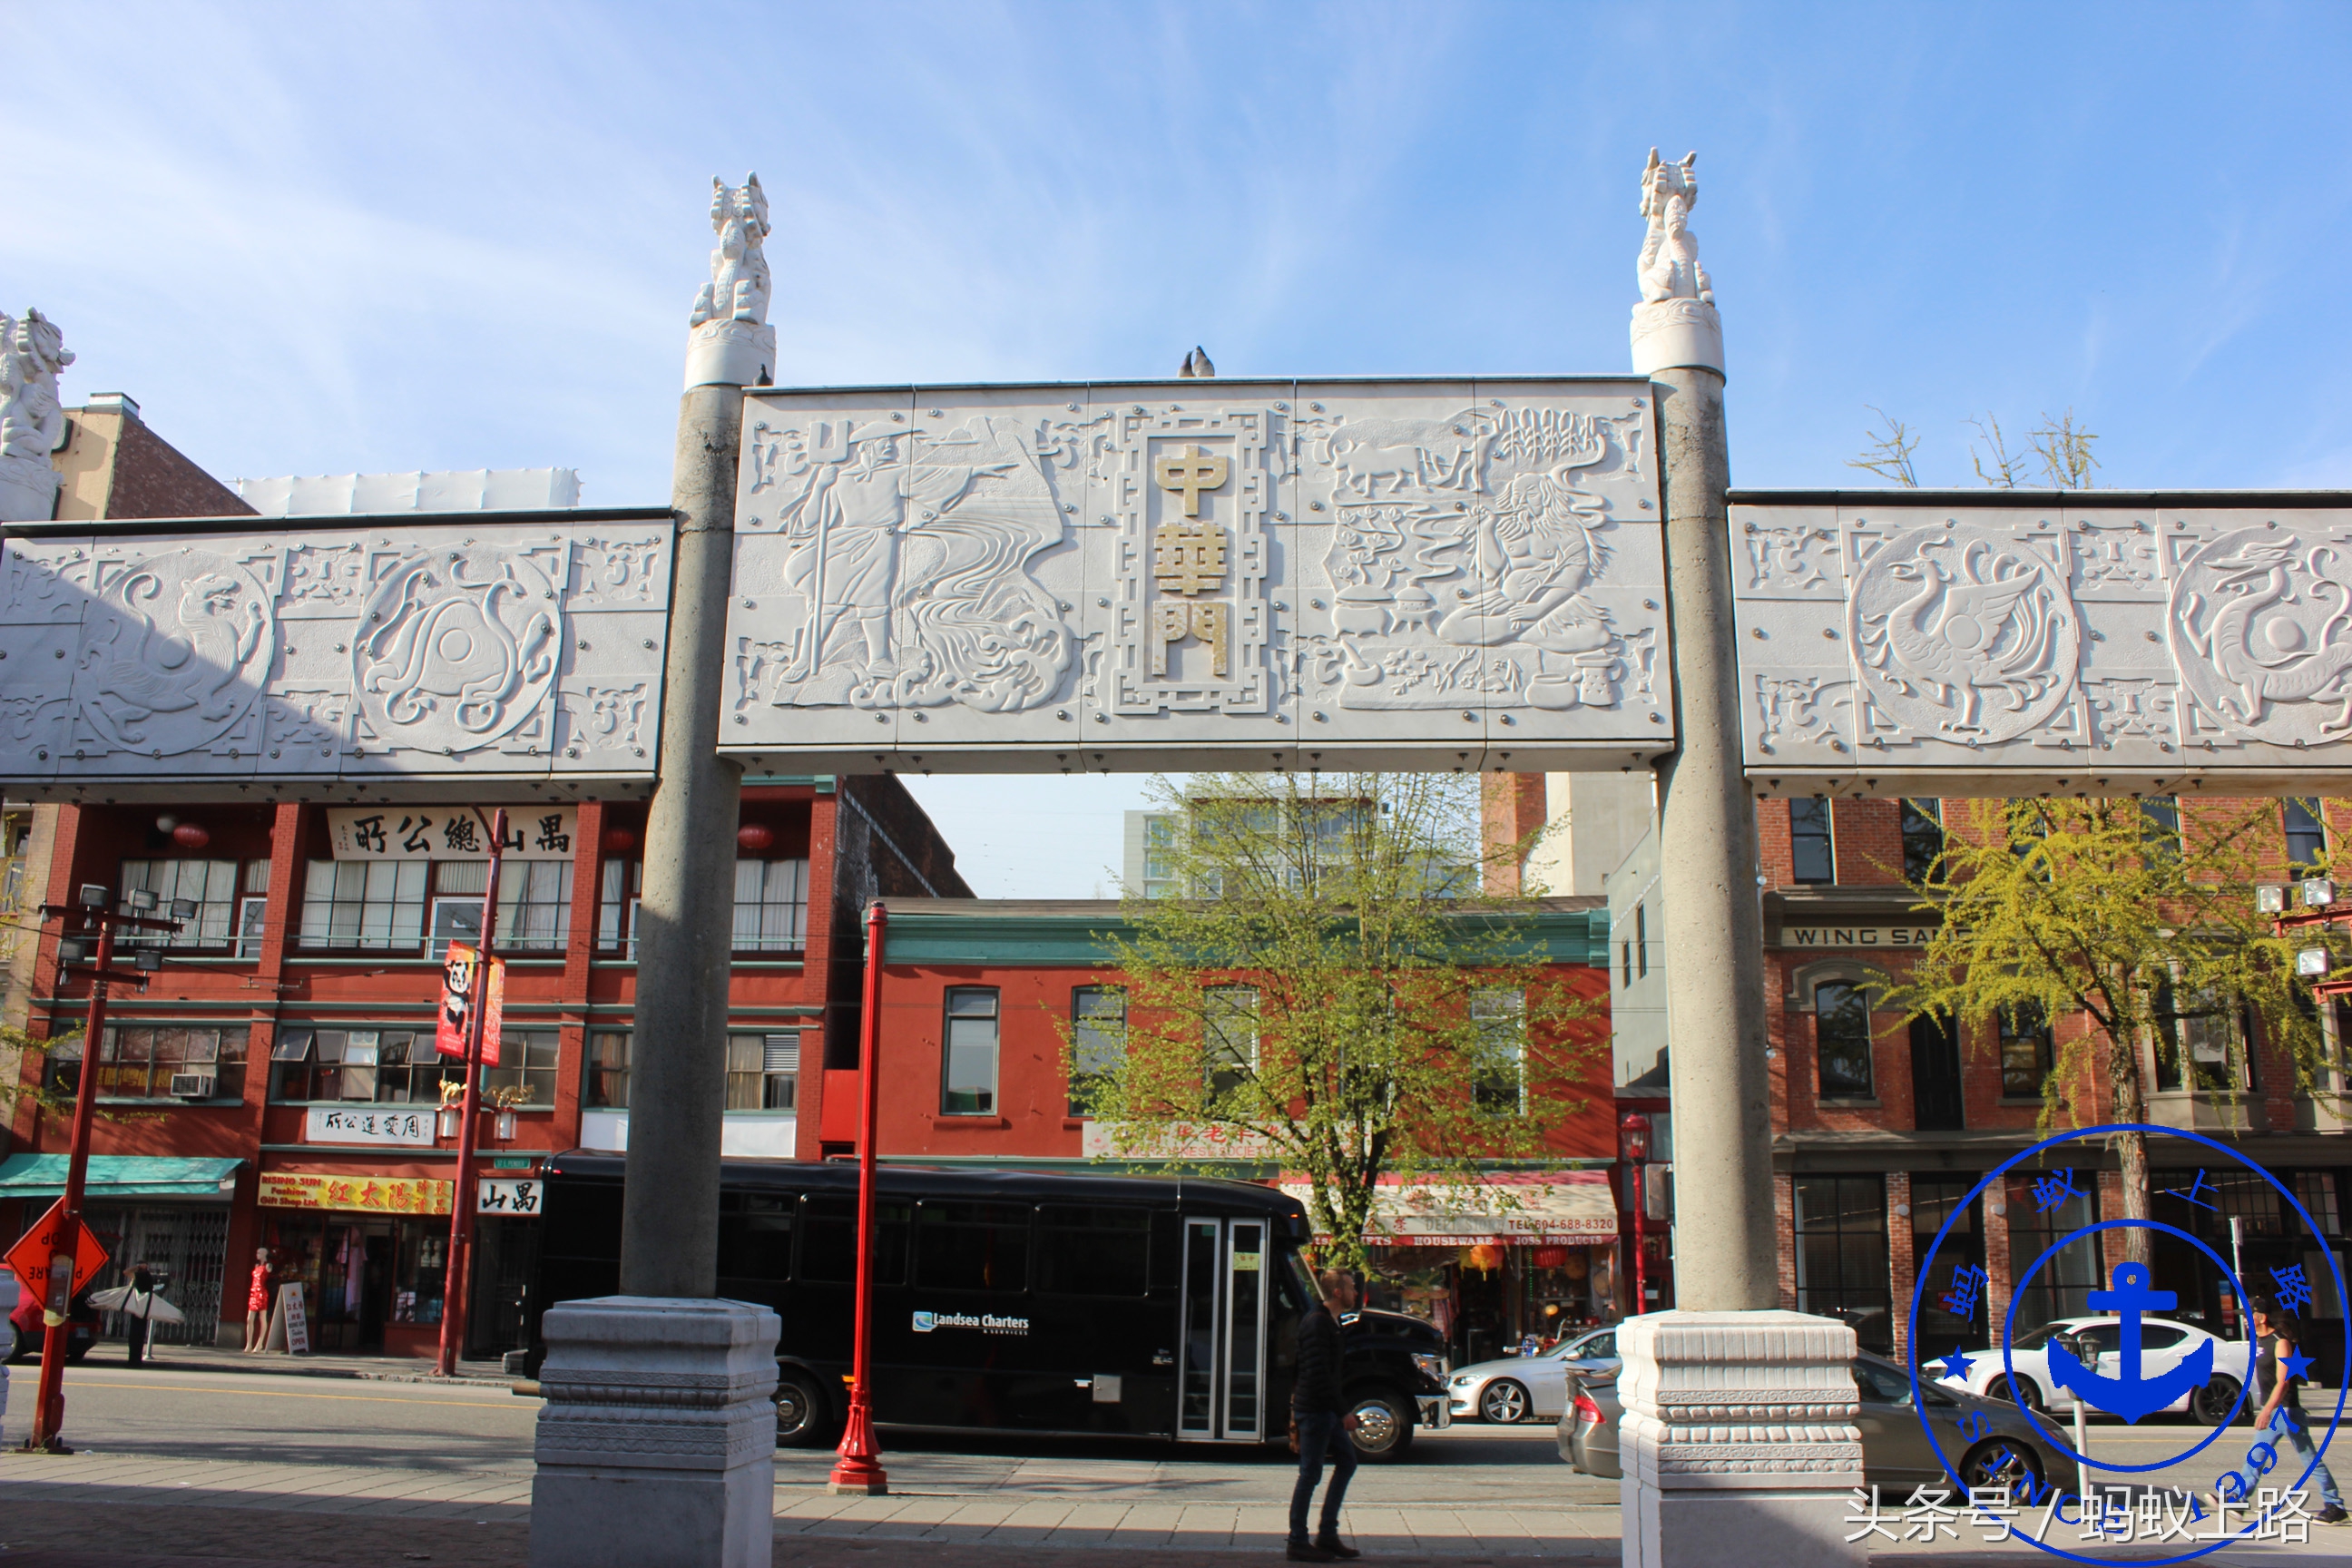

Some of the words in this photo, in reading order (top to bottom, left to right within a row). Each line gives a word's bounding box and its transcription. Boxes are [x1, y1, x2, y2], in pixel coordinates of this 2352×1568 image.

[1151, 444, 1228, 676] 中華門
[1793, 928, 1878, 945] WING
[261, 1175, 296, 1185] RISING
[299, 1177, 321, 1187] SUN
[270, 1186, 308, 1196] Fashion
[328, 1180, 411, 1210] 紅太陽
[260, 1196, 279, 1205] Gift
[279, 1197, 302, 1208] Shop
[303, 1199, 320, 1207] Ltd.
[1361, 1235, 1393, 1246] IFTS
[1413, 1235, 1494, 1246] HOUSEWARE
[1514, 1235, 1543, 1246] JOSS
[1545, 1235, 1603, 1245] PRODUCTS
[933, 1311, 980, 1326] Landsea
[981, 1313, 1030, 1328] Charters
